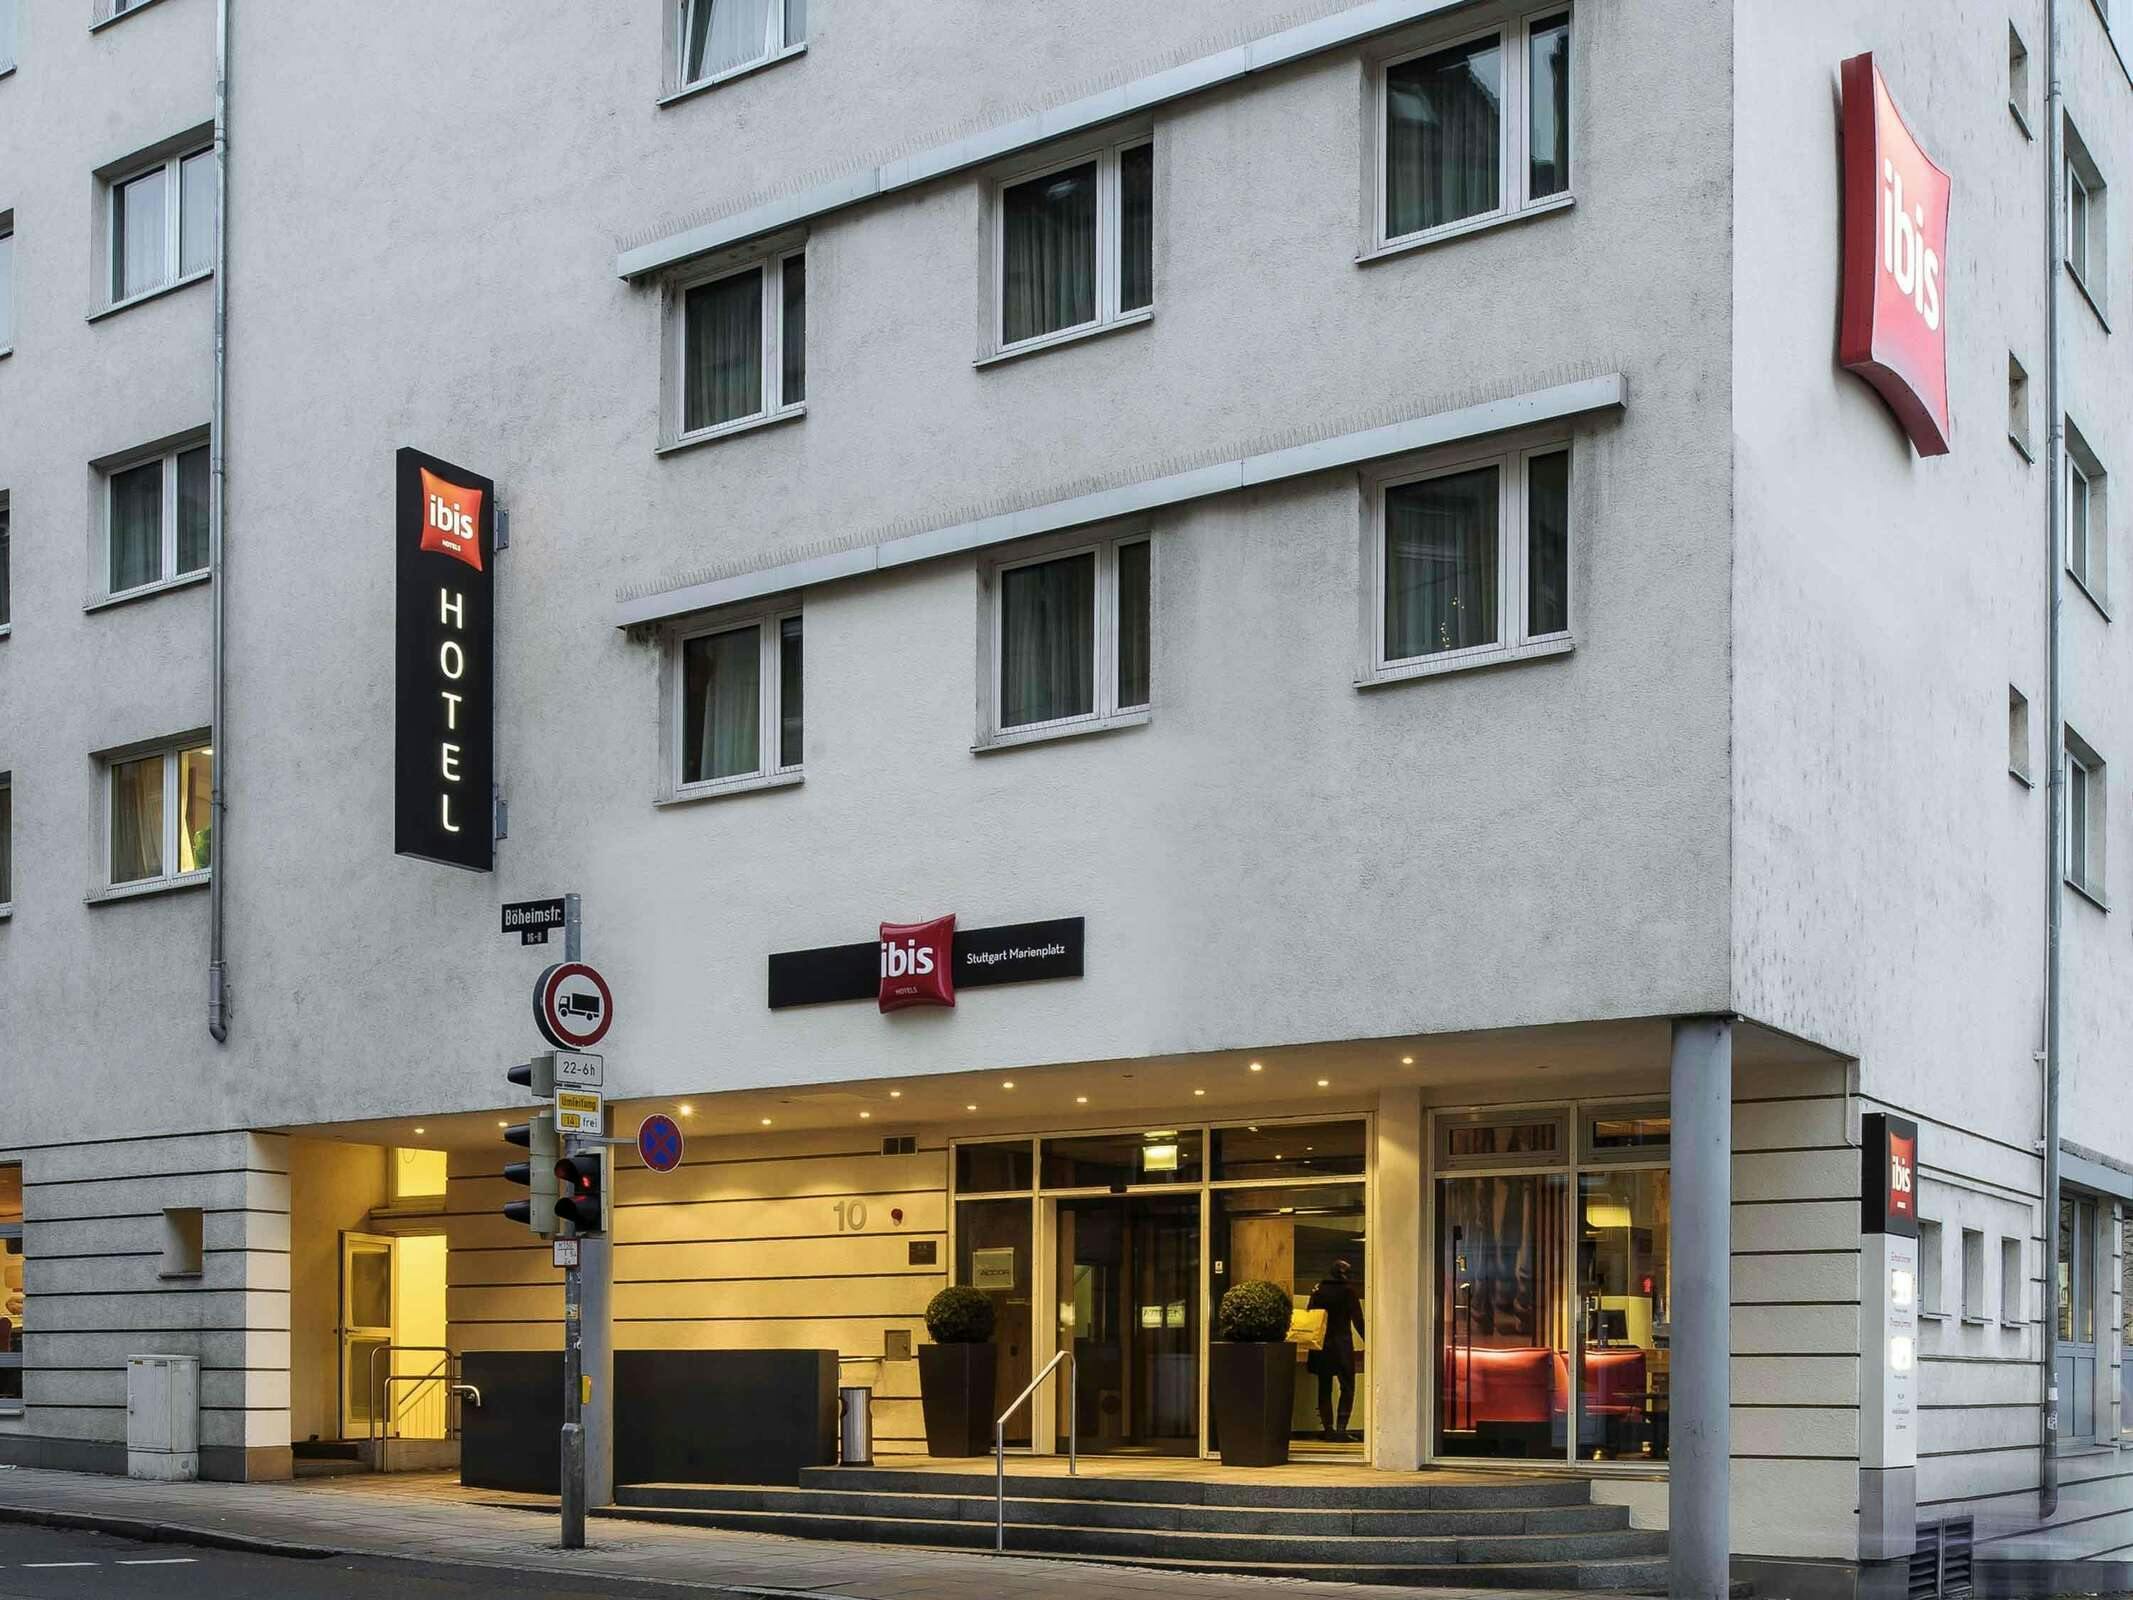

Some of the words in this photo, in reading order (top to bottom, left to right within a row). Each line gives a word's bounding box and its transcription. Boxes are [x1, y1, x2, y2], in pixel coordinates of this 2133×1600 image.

[1881, 158, 1940, 331] ibis
[428, 493, 474, 540] ibis
[439, 587, 465, 833] HOTEL
[504, 906, 562, 926] Böheimstr.
[880, 939, 934, 979] ibis
[966, 948, 1008, 966] Stuttgart
[1008, 944, 1066, 961] Marienplatz
[582, 1116, 598, 1128] frei
[1891, 1154, 1911, 1193] ibis
[832, 1198, 868, 1232] 10
